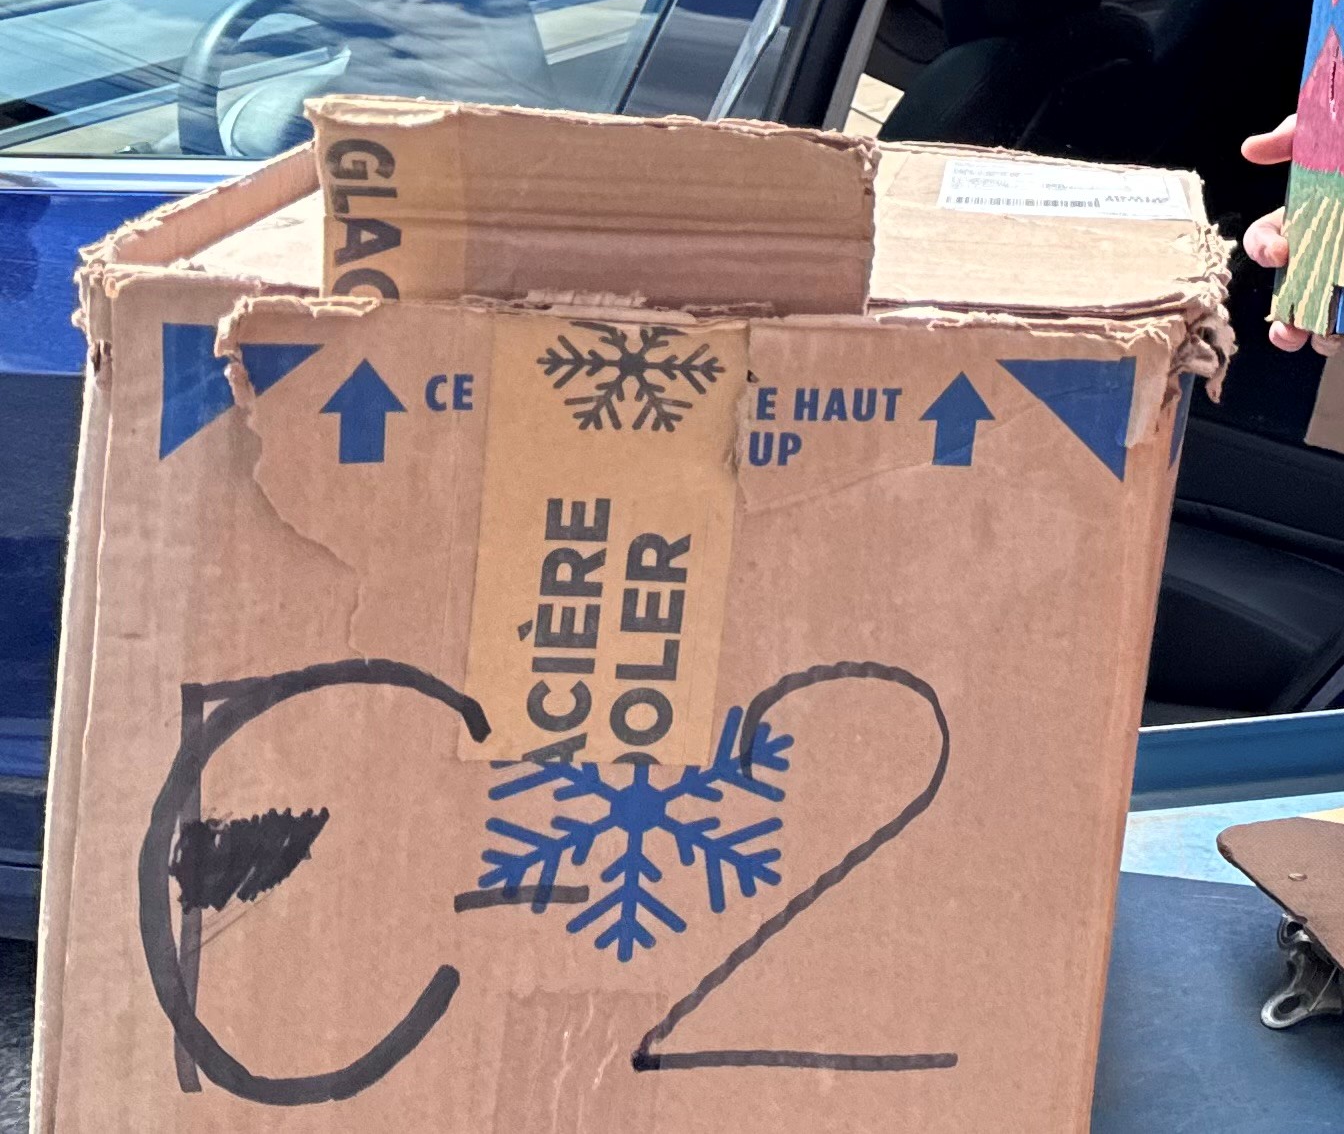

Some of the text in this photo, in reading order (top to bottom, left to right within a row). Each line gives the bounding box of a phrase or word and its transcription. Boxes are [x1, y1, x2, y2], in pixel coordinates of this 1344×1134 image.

[424, 374, 903, 422] CE E HAUT
[748, 431, 803, 466] UP
